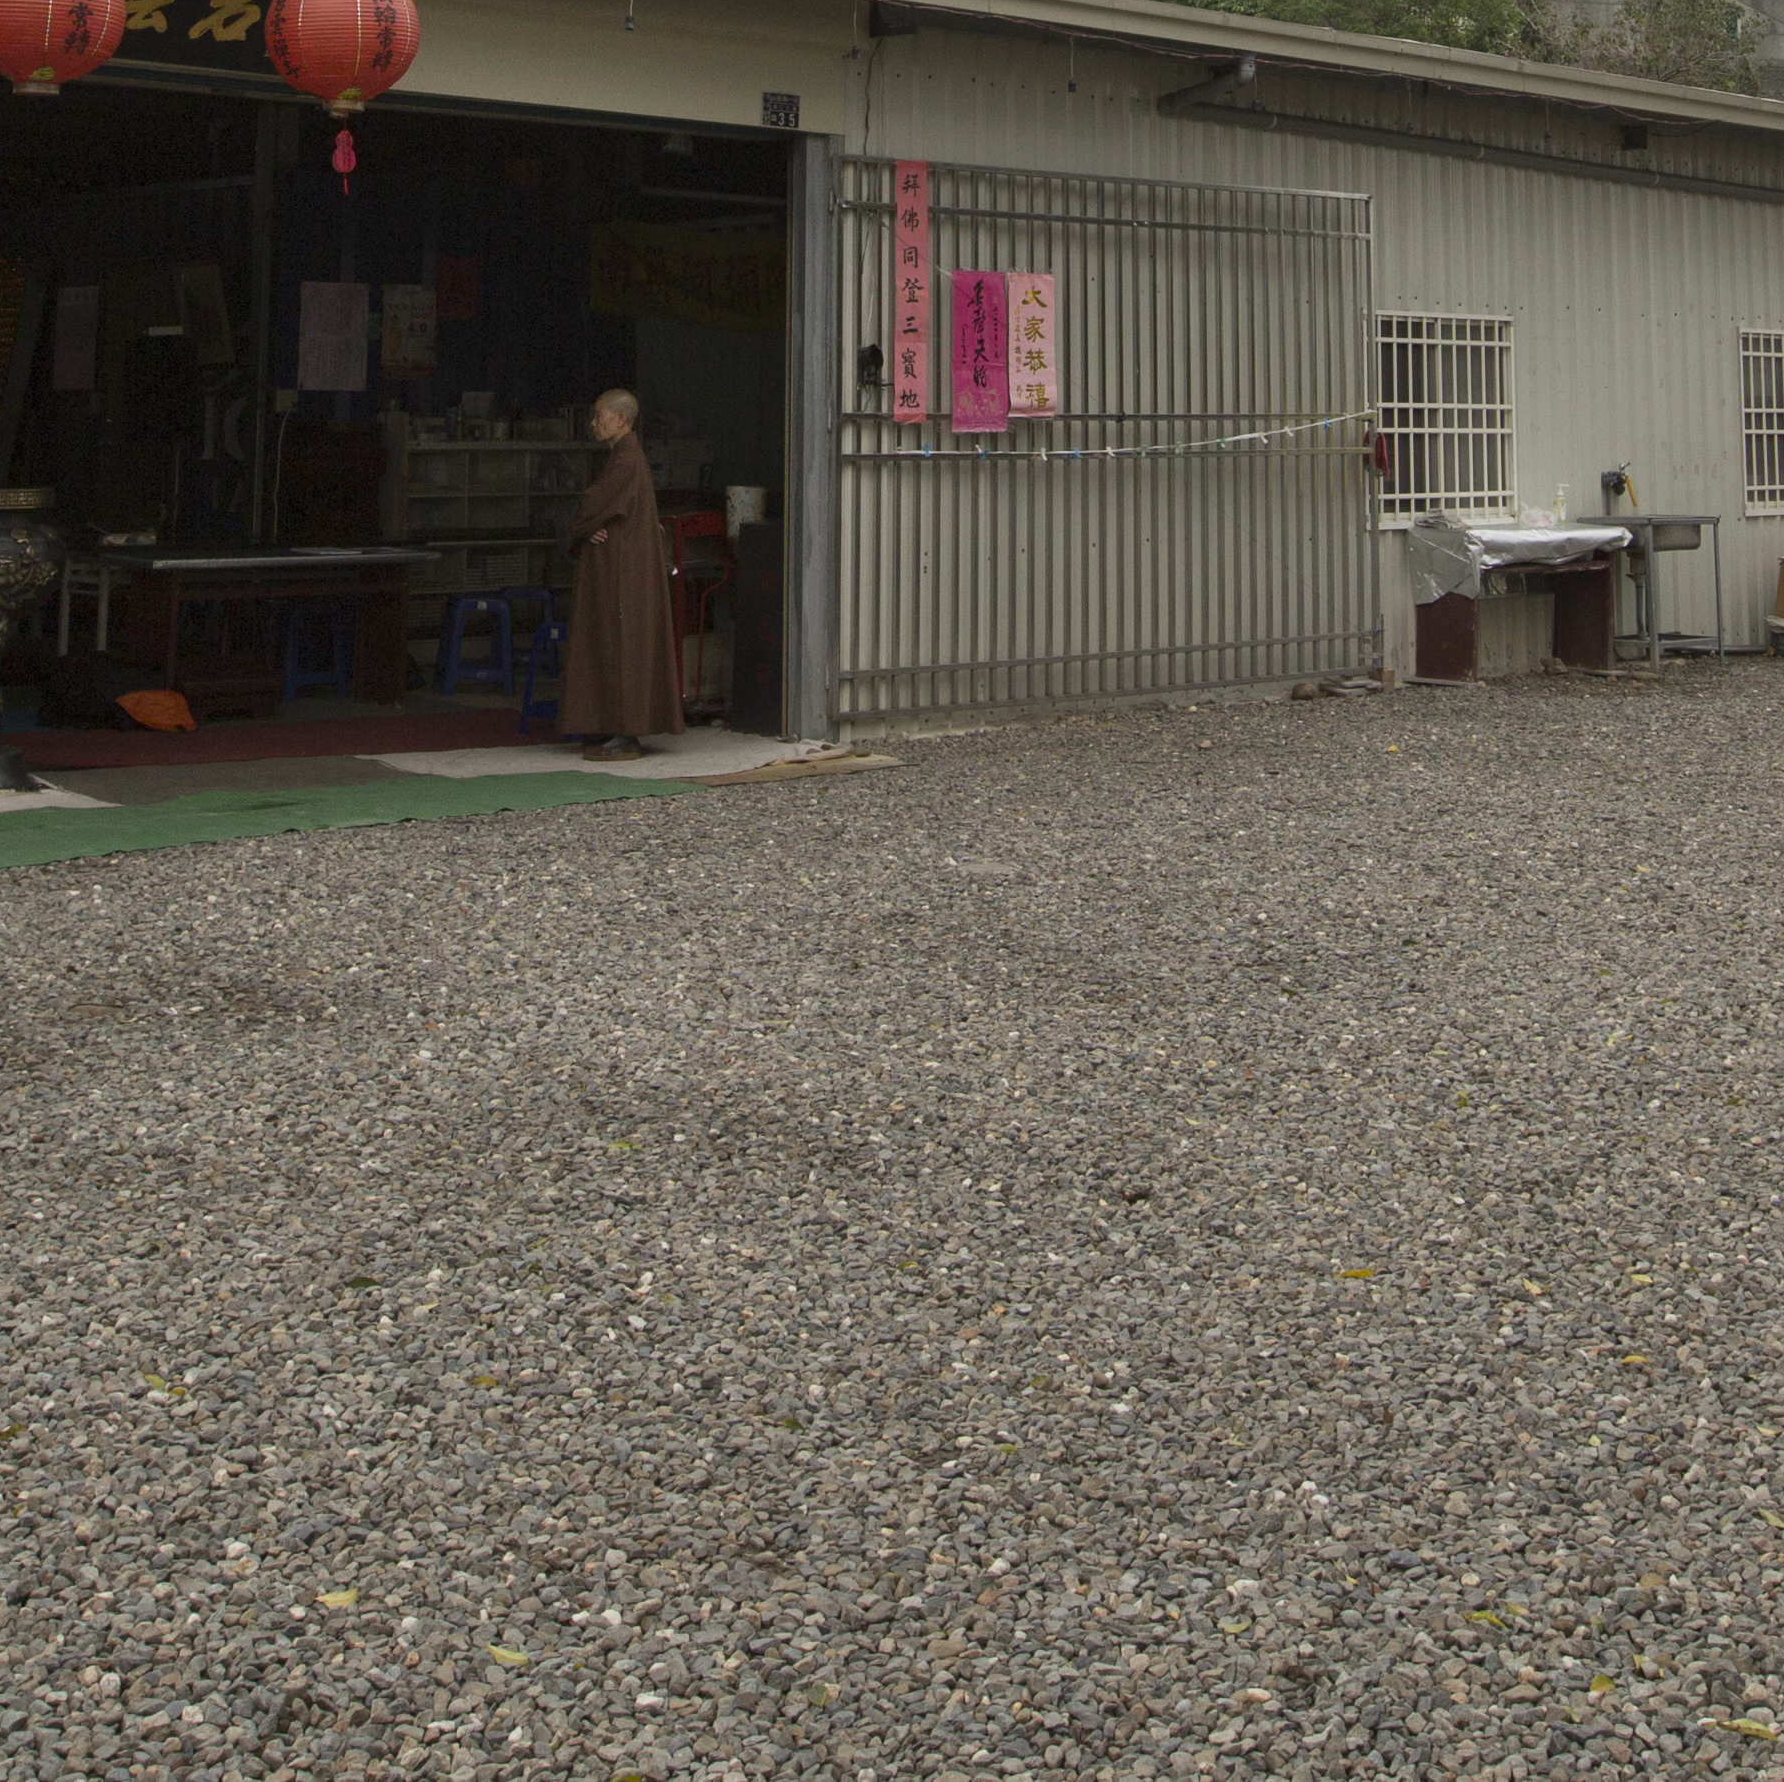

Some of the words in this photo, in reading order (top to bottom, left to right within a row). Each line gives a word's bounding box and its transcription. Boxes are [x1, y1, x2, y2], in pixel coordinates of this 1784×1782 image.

[899, 173, 924, 409] 拜佛同登三寶地
[1021, 285, 1050, 409] 大家恭禧
